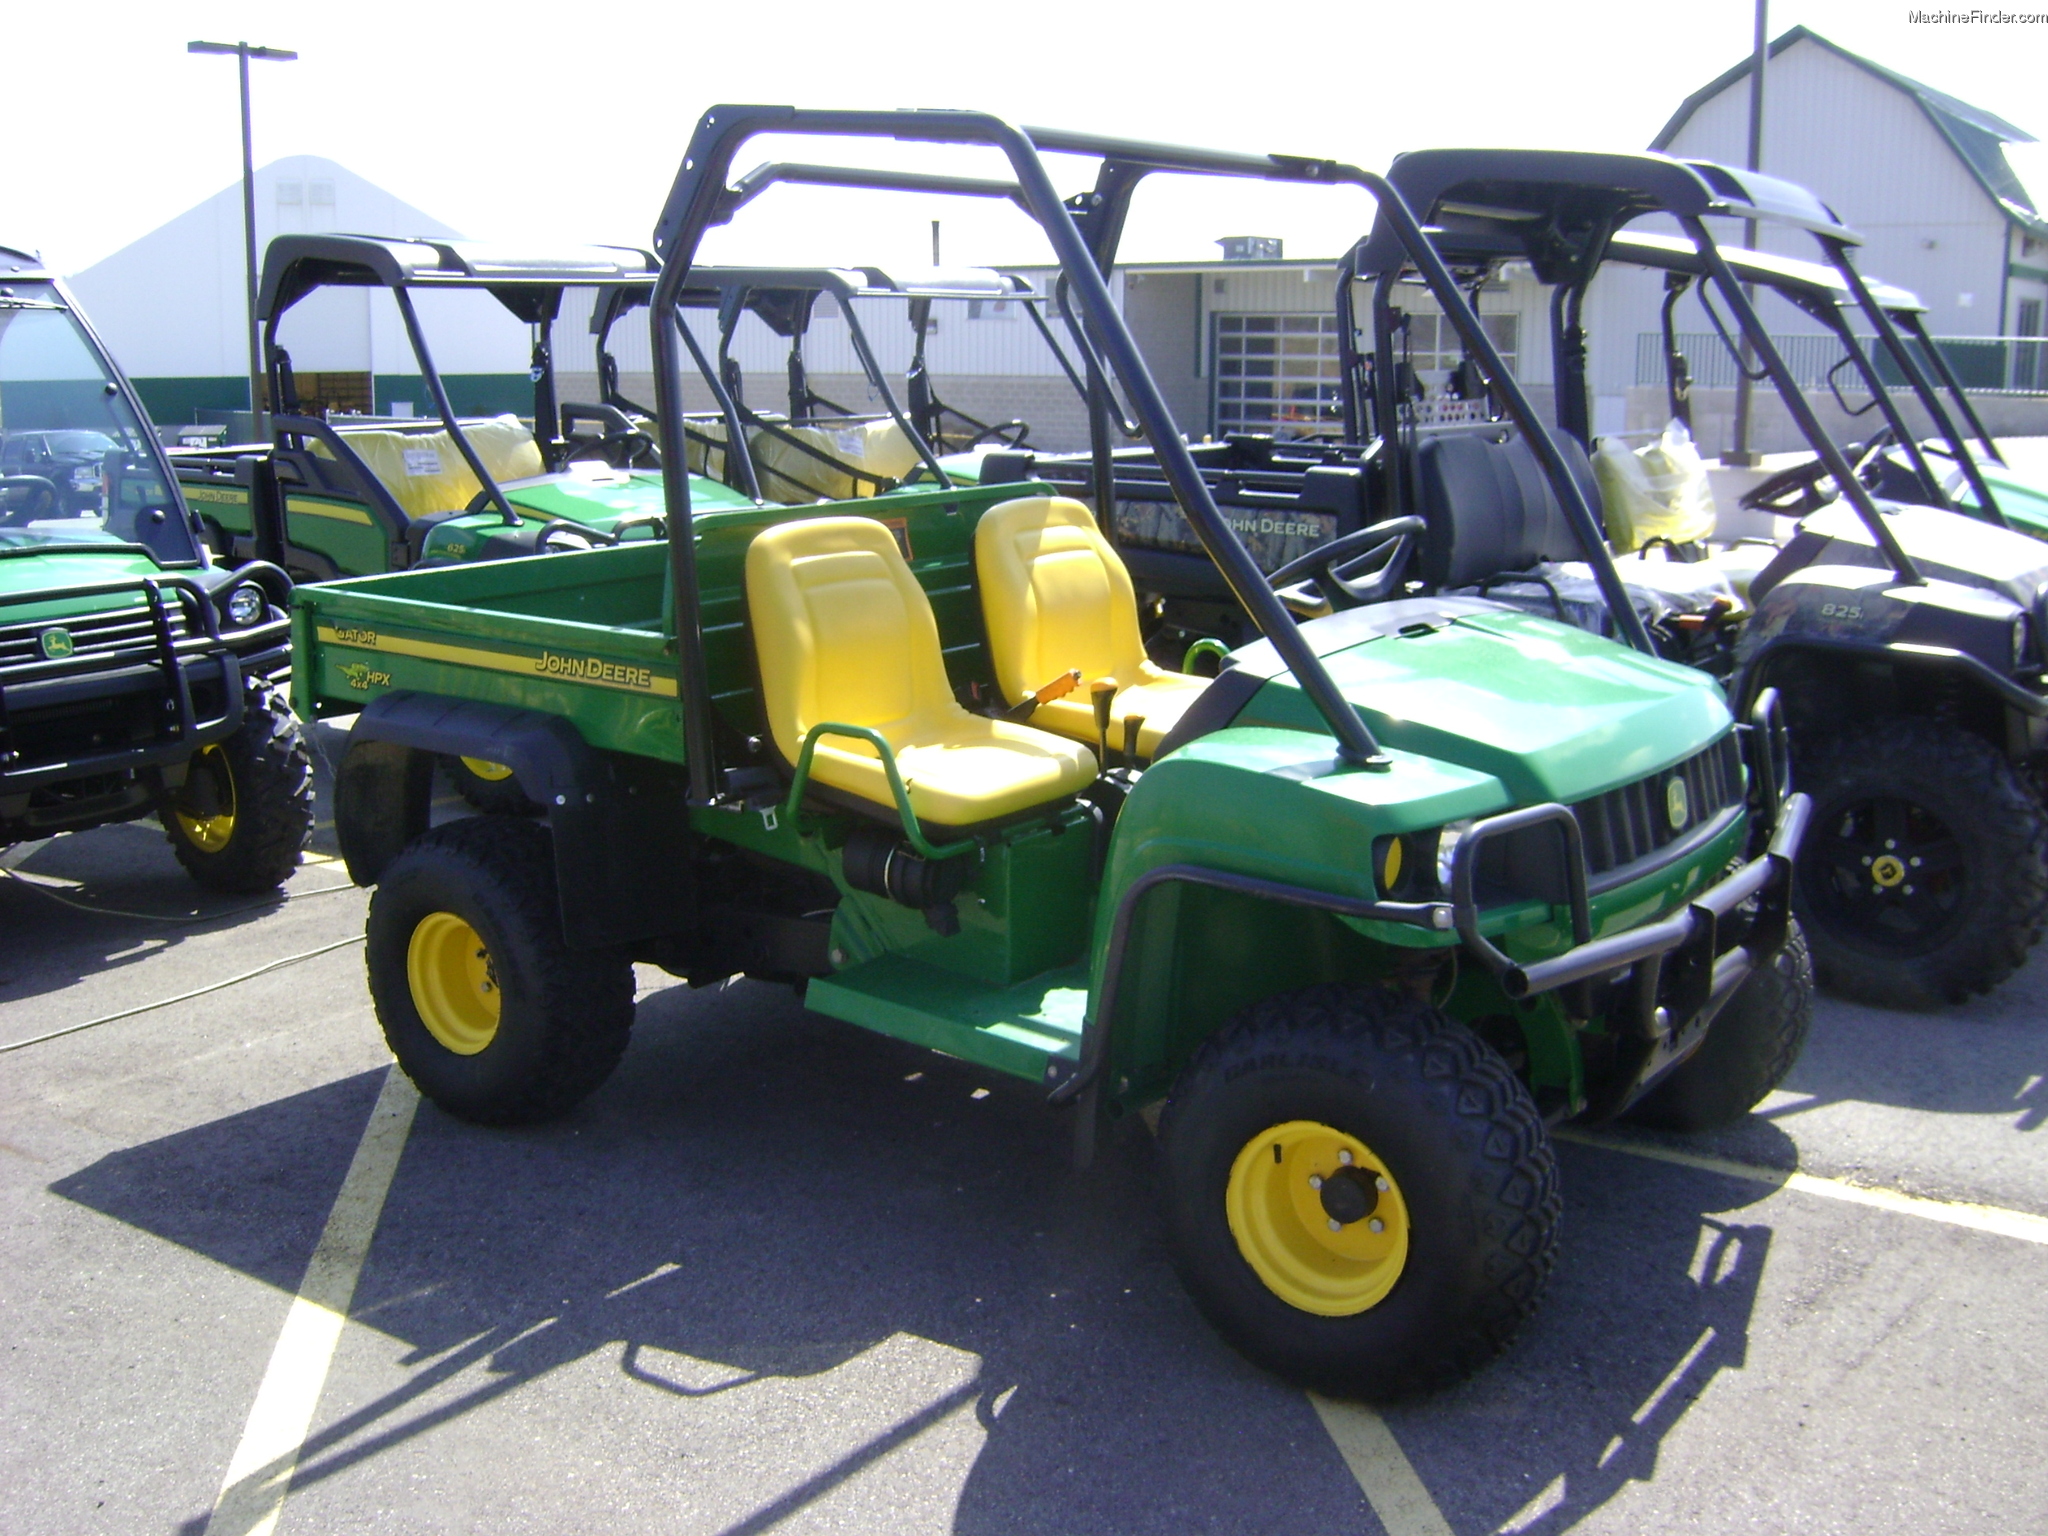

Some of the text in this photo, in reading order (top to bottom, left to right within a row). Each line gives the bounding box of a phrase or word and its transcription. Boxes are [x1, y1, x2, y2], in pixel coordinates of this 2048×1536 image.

[1223, 518, 1320, 538] OHN DEERE
[334, 627, 377, 645] GATOR
[535, 651, 651, 687] JOHN DEERE
[366, 671, 391, 687] HPX
